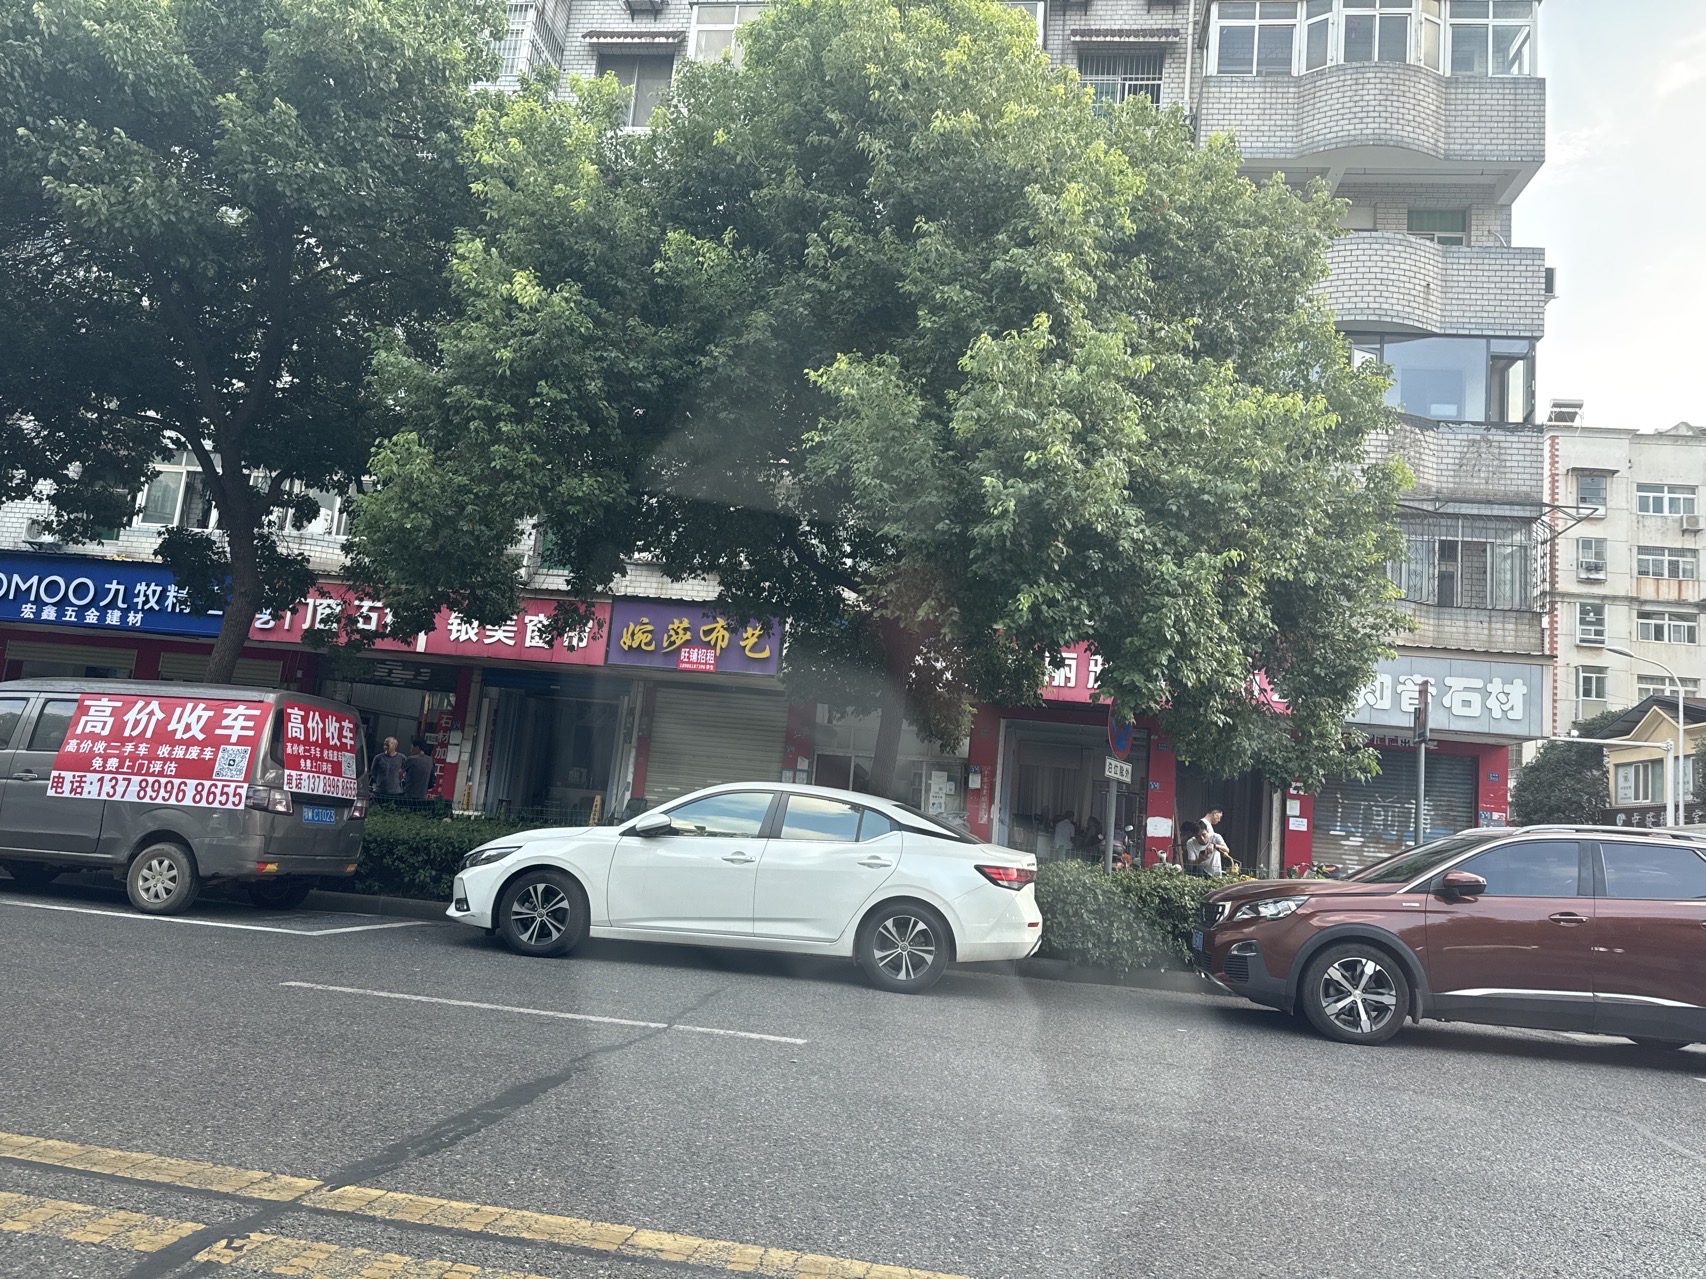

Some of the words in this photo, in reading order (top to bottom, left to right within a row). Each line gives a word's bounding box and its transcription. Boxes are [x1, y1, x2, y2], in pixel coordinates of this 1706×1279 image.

[0, 572, 95, 606] MOO
[20, 602, 144, 627] 宏鑫五金建材
[619, 617, 771, 659] 婉莎布艺
[681, 648, 715, 664] 旺铺招租
[75, 697, 262, 744] 高价收车
[286, 706, 355, 750] 高价收车
[64, 739, 150, 757] 高价收二手车
[157, 743, 216, 761] 收报废车
[286, 742, 321, 758] 高价收二手车
[434, 714, 453, 777] 石材加工
[90, 756, 178, 776] 免费上门评估
[300, 758, 333, 775] 免费上门评估
[136, 777, 188, 804] 8996
[191, 780, 245, 809] 8655
[322, 775, 340, 796] 8996
[340, 778, 358, 799] 8655
